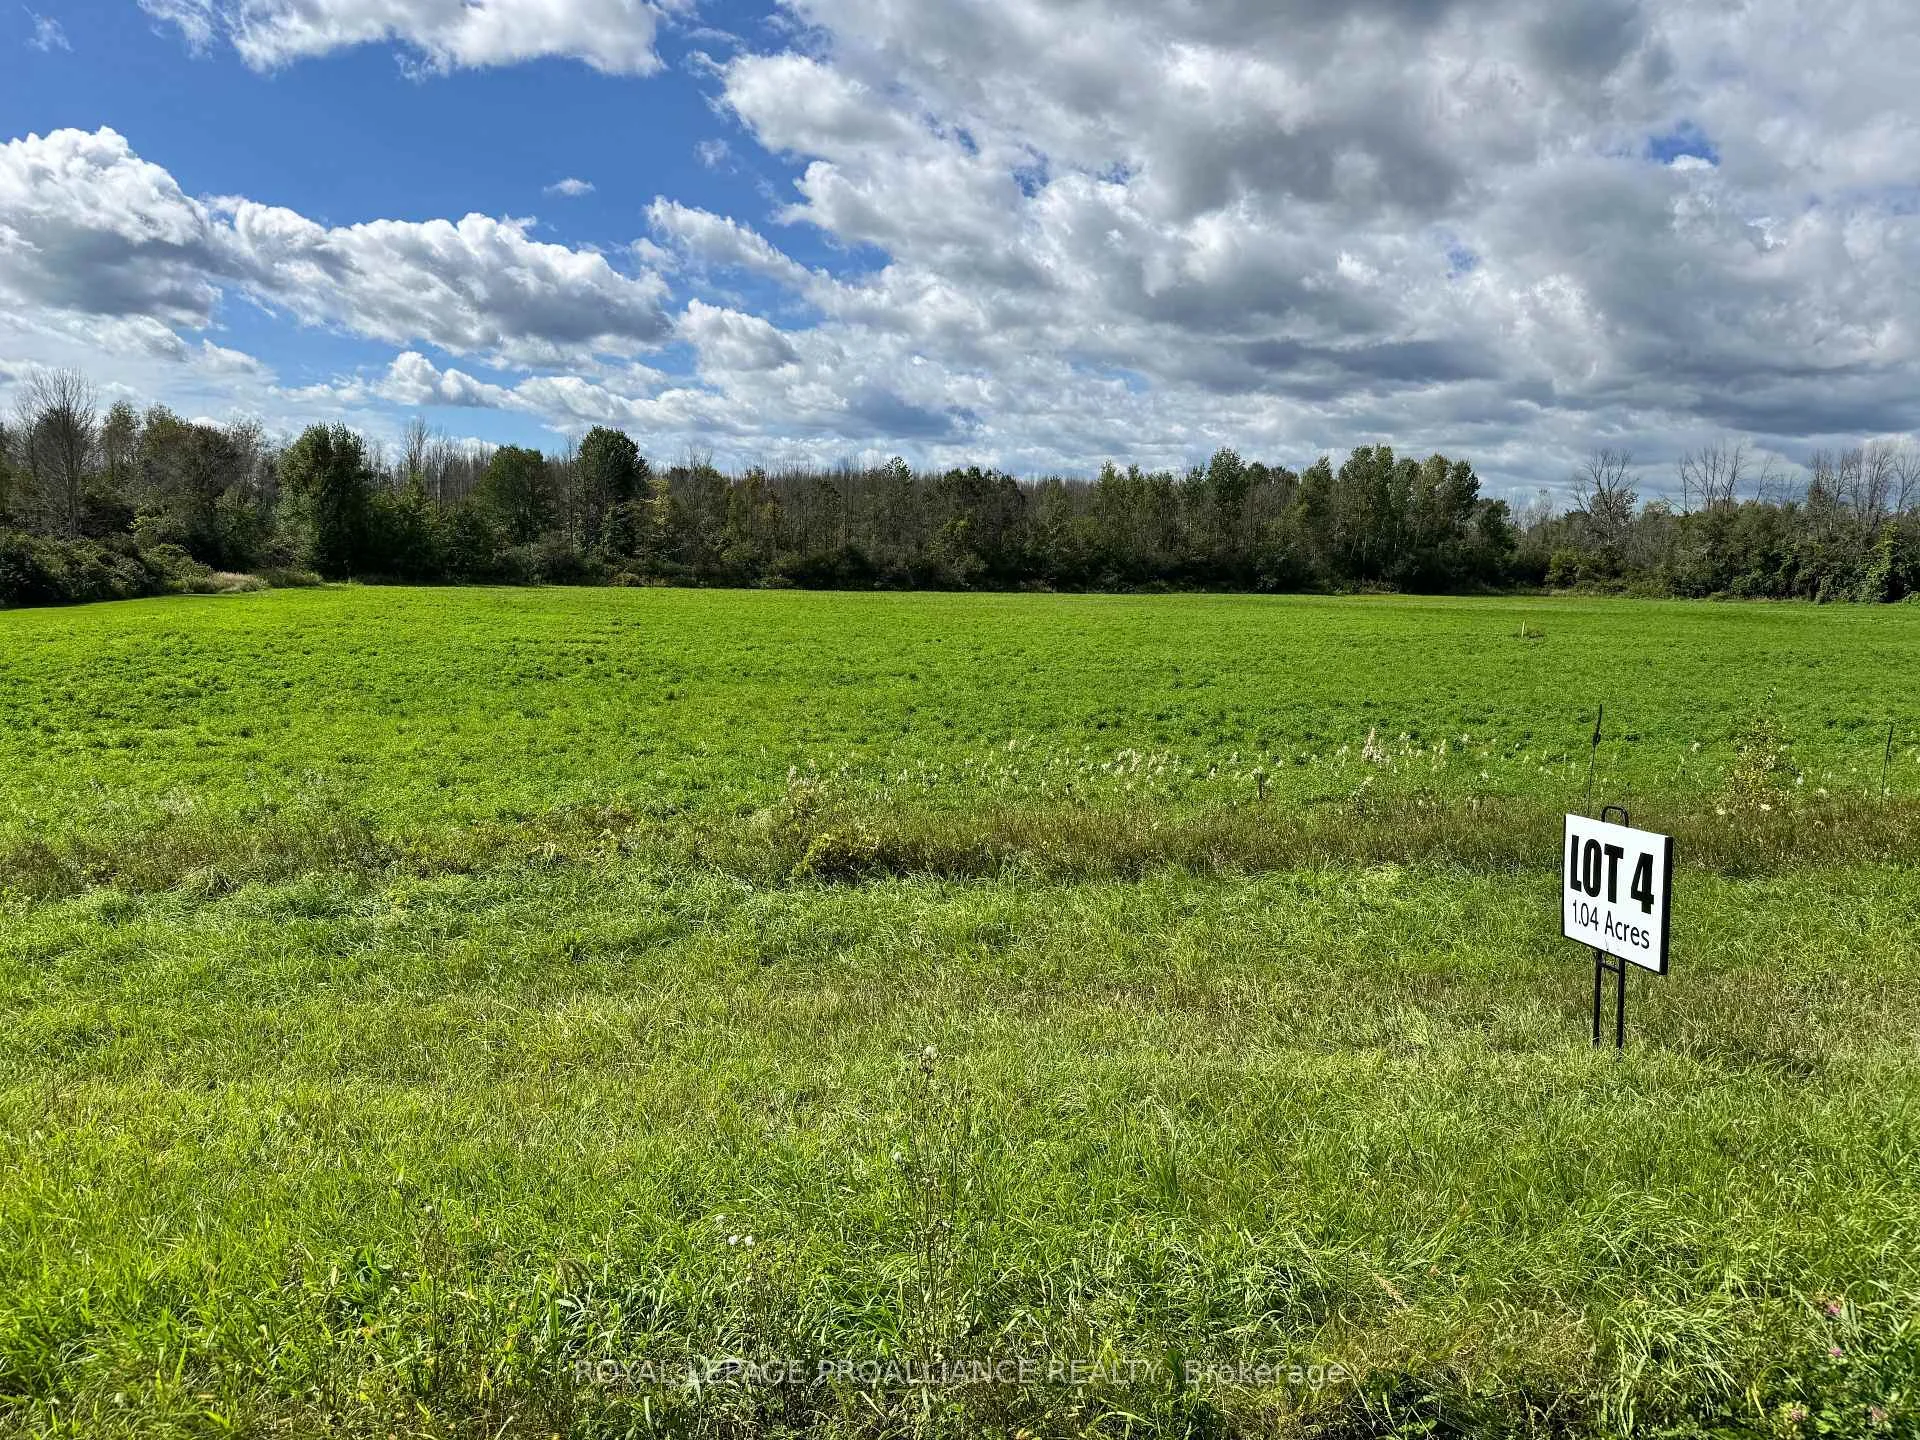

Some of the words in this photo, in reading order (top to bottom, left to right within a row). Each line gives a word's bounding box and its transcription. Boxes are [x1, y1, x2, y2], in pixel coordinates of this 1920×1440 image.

[1570, 834, 1624, 904] LOT
[1630, 852, 1655, 914] 4
[1573, 899, 1599, 931] 1.04
[1604, 910, 1650, 950] Acres
